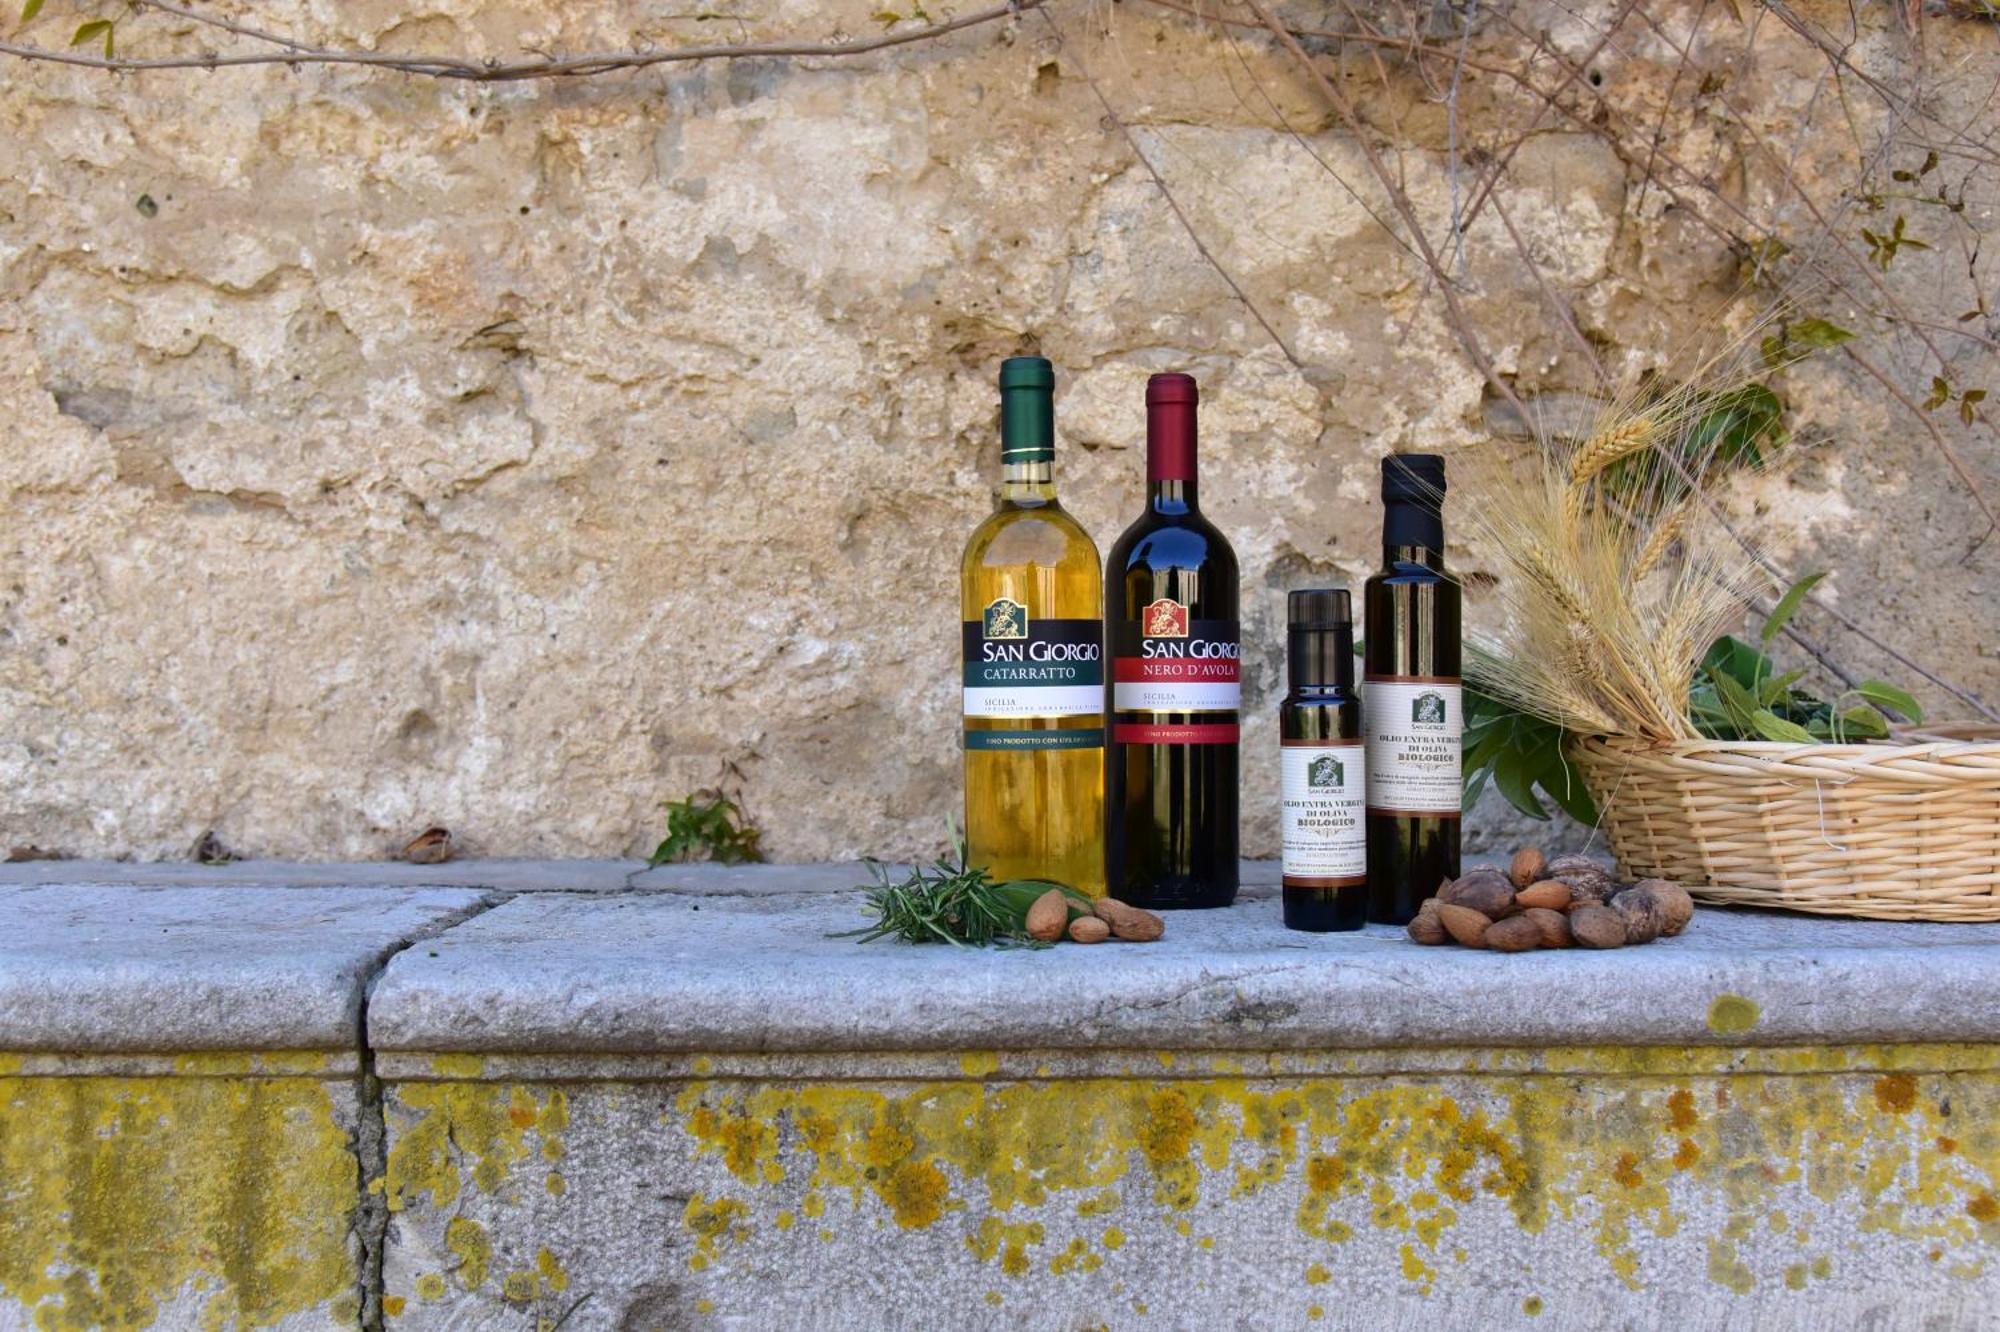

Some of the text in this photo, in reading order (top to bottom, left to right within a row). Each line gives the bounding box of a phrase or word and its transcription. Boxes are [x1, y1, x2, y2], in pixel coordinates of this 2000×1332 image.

[983, 641, 1099, 662] SAN GIORGIO
[1142, 640, 1184, 659] SAN
[984, 667, 1076, 680] CATARRATTO
[1144, 664, 1235, 676] NERO D'AVOLA
[1143, 693, 1176, 701] SICILIA
[1398, 753, 1455, 762] BIOLOGICO
[1302, 800, 1333, 808] EXTRA
[1297, 818, 1356, 827] BIOLOGICO
